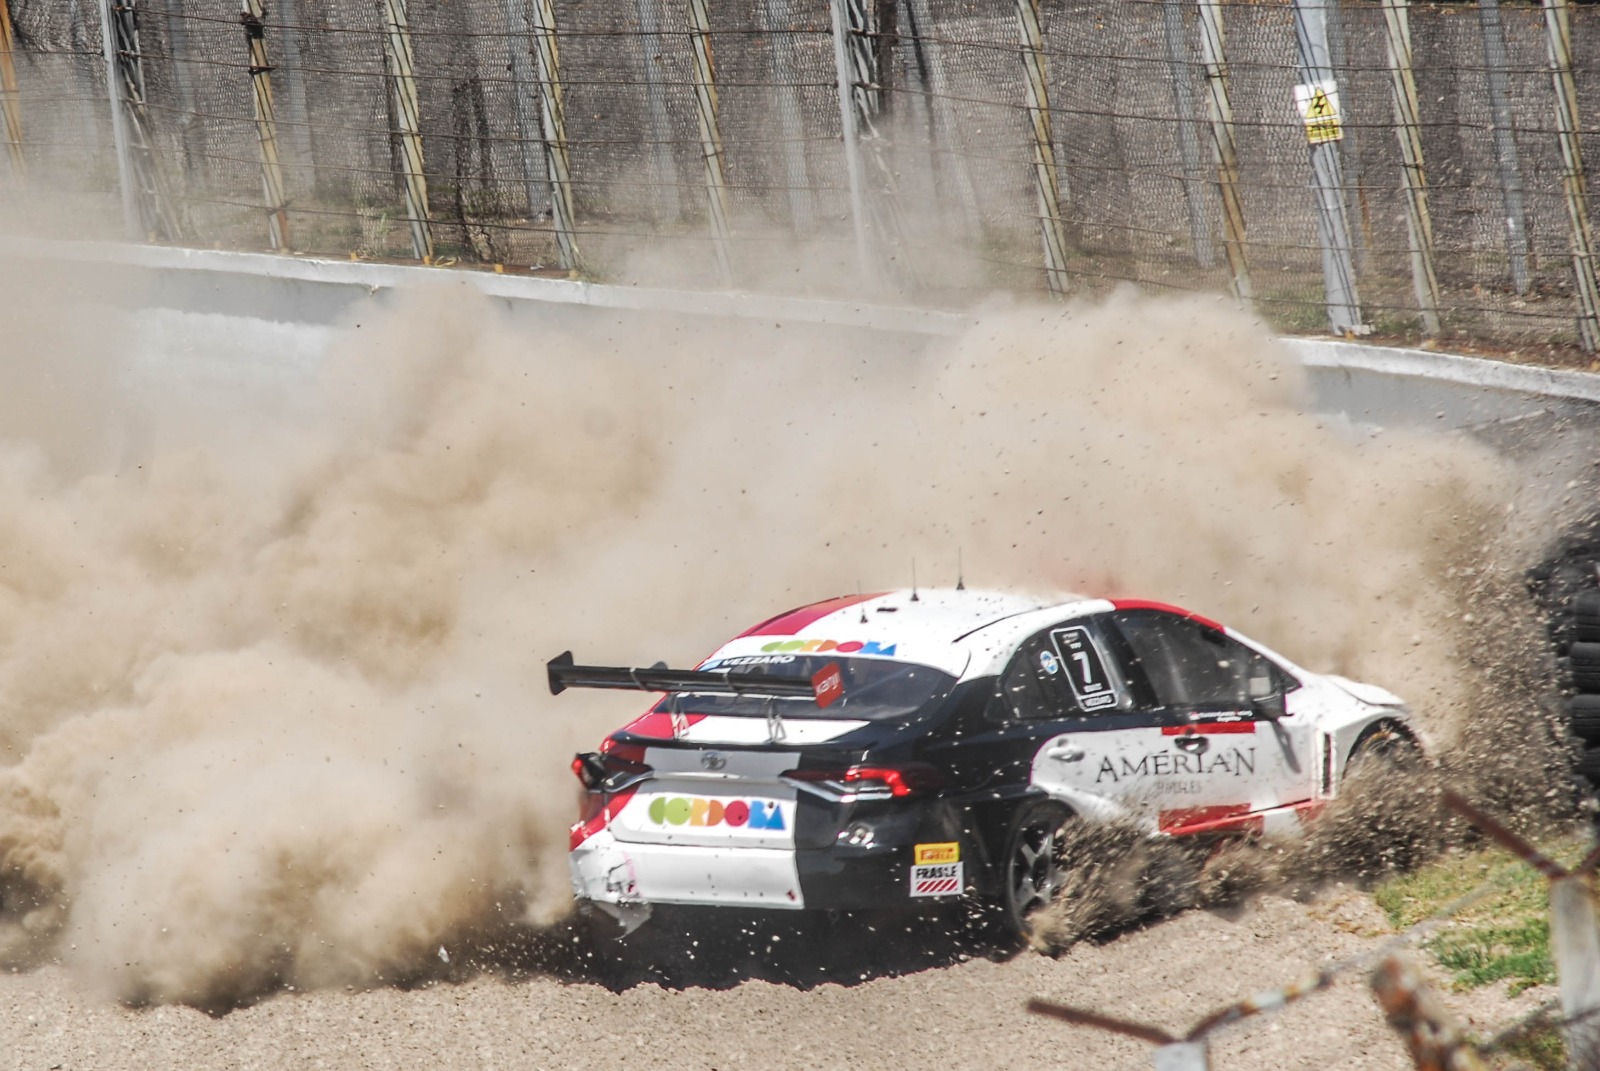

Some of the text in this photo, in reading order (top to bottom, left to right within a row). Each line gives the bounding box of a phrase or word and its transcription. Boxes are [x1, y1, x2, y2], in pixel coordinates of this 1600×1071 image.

[761, 639, 897, 656] CORDOBA
[722, 655, 796, 666] VEZZARO
[1072, 651, 1092, 683] 7
[648, 796, 786, 830] CORDOBA
